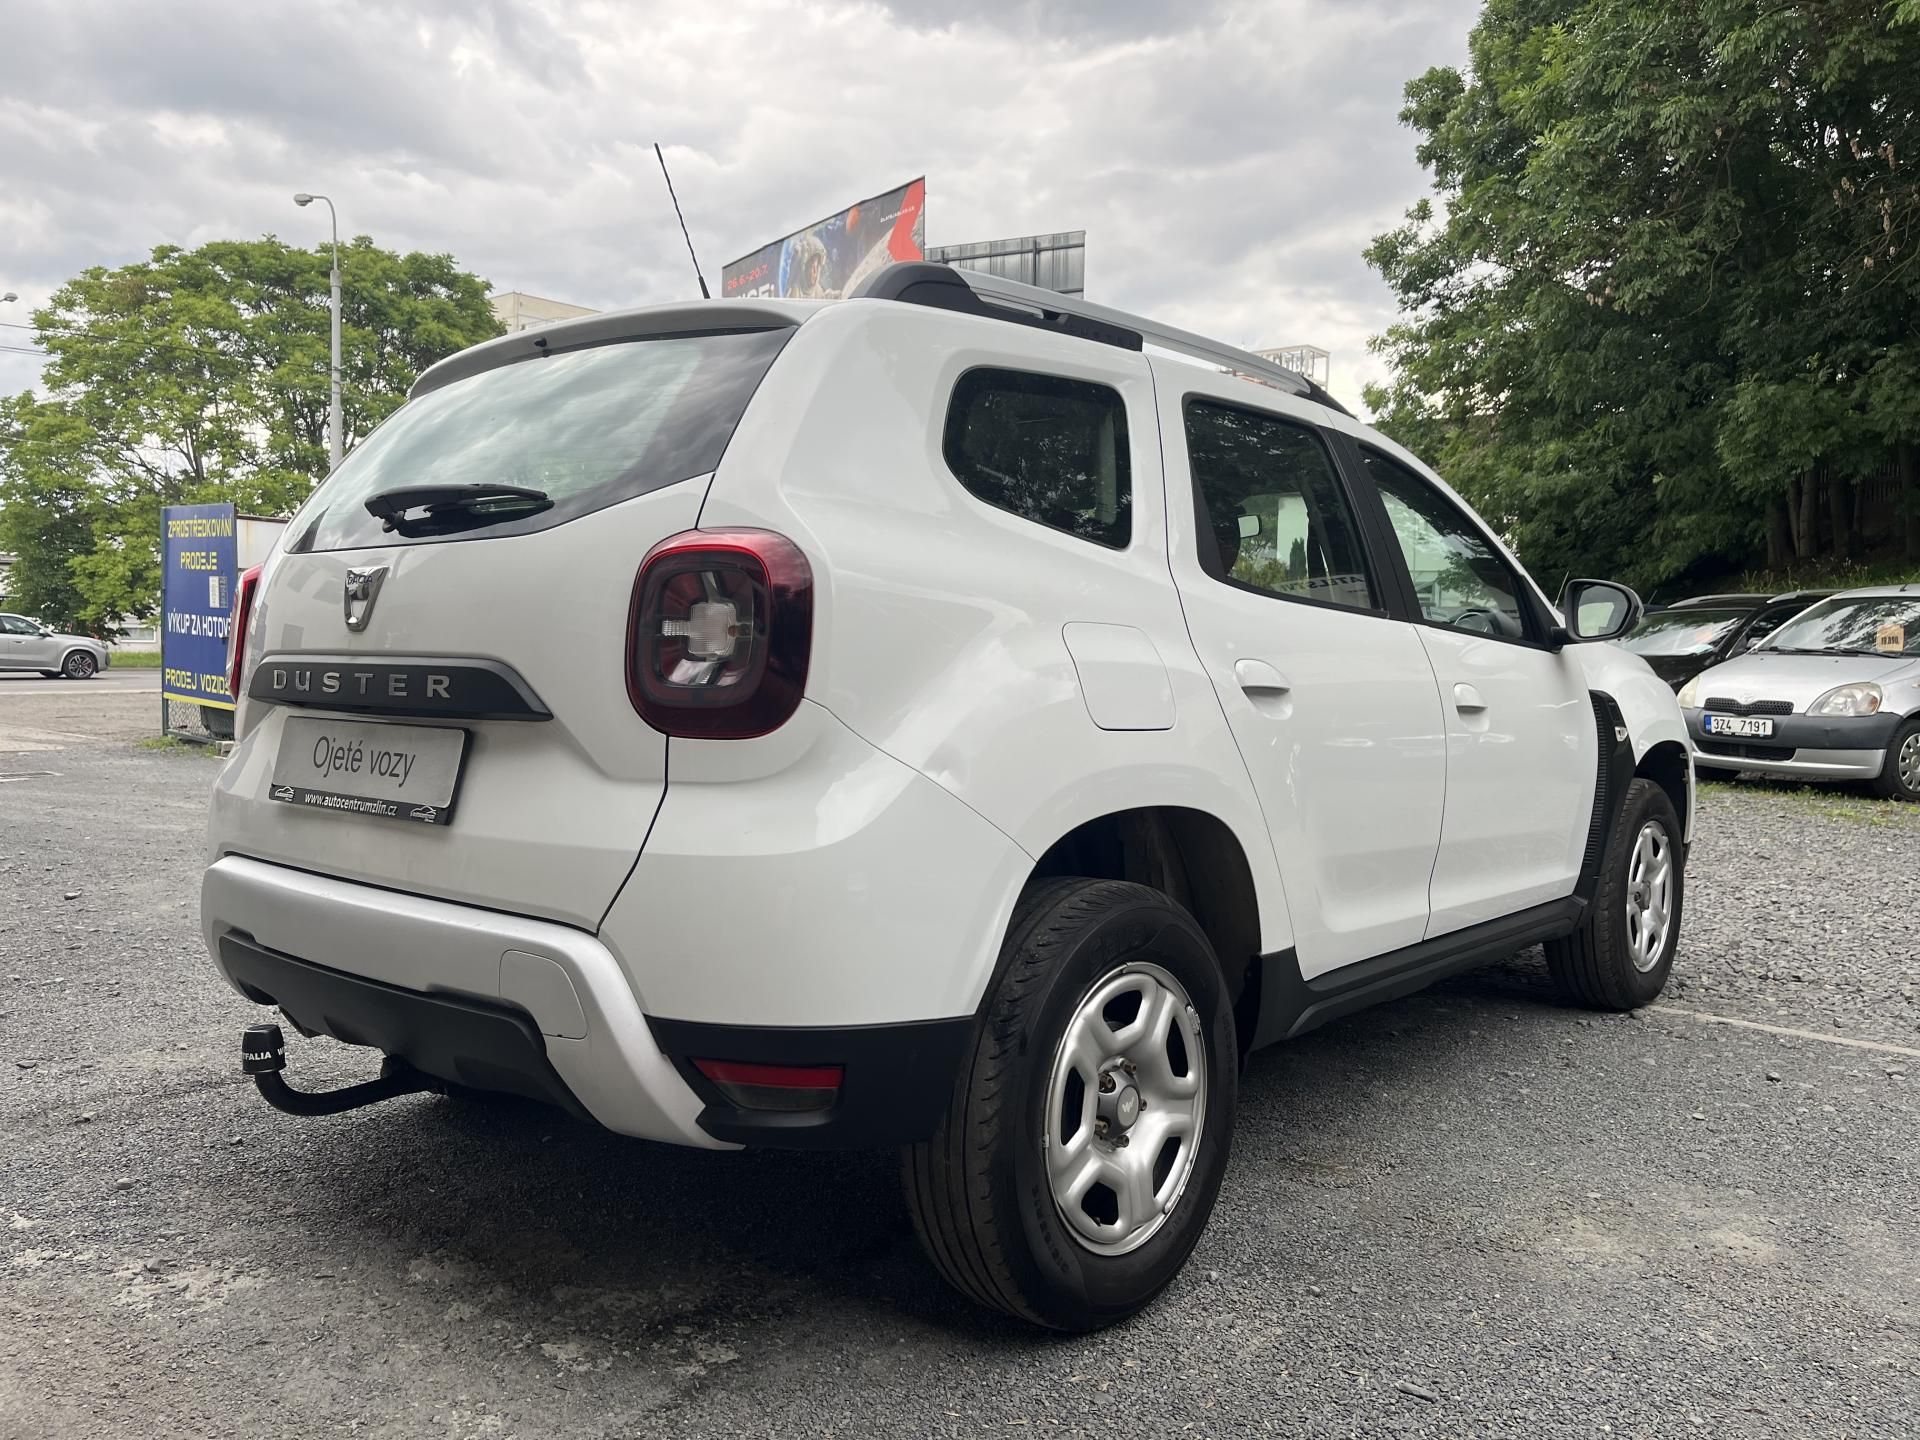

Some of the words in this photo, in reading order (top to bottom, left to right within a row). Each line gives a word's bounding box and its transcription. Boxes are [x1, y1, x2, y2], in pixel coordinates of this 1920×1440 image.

[167, 513, 233, 539] ZPROSTŘEDKOVÁNÍ
[180, 552, 217, 570] PRODEJE
[347, 575, 373, 585] DACIA
[167, 607, 190, 634] VÝKUP
[191, 614, 202, 636] ZA
[165, 668, 198, 690] PRODEJ
[272, 669, 452, 699] DUSTER
[1713, 718, 1732, 731] 3Z4
[1740, 720, 1767, 733] 7191
[313, 736, 364, 778] Ojeté
[369, 750, 417, 788] vozy
[304, 792, 398, 816] www.autocentrumzlin.cz
